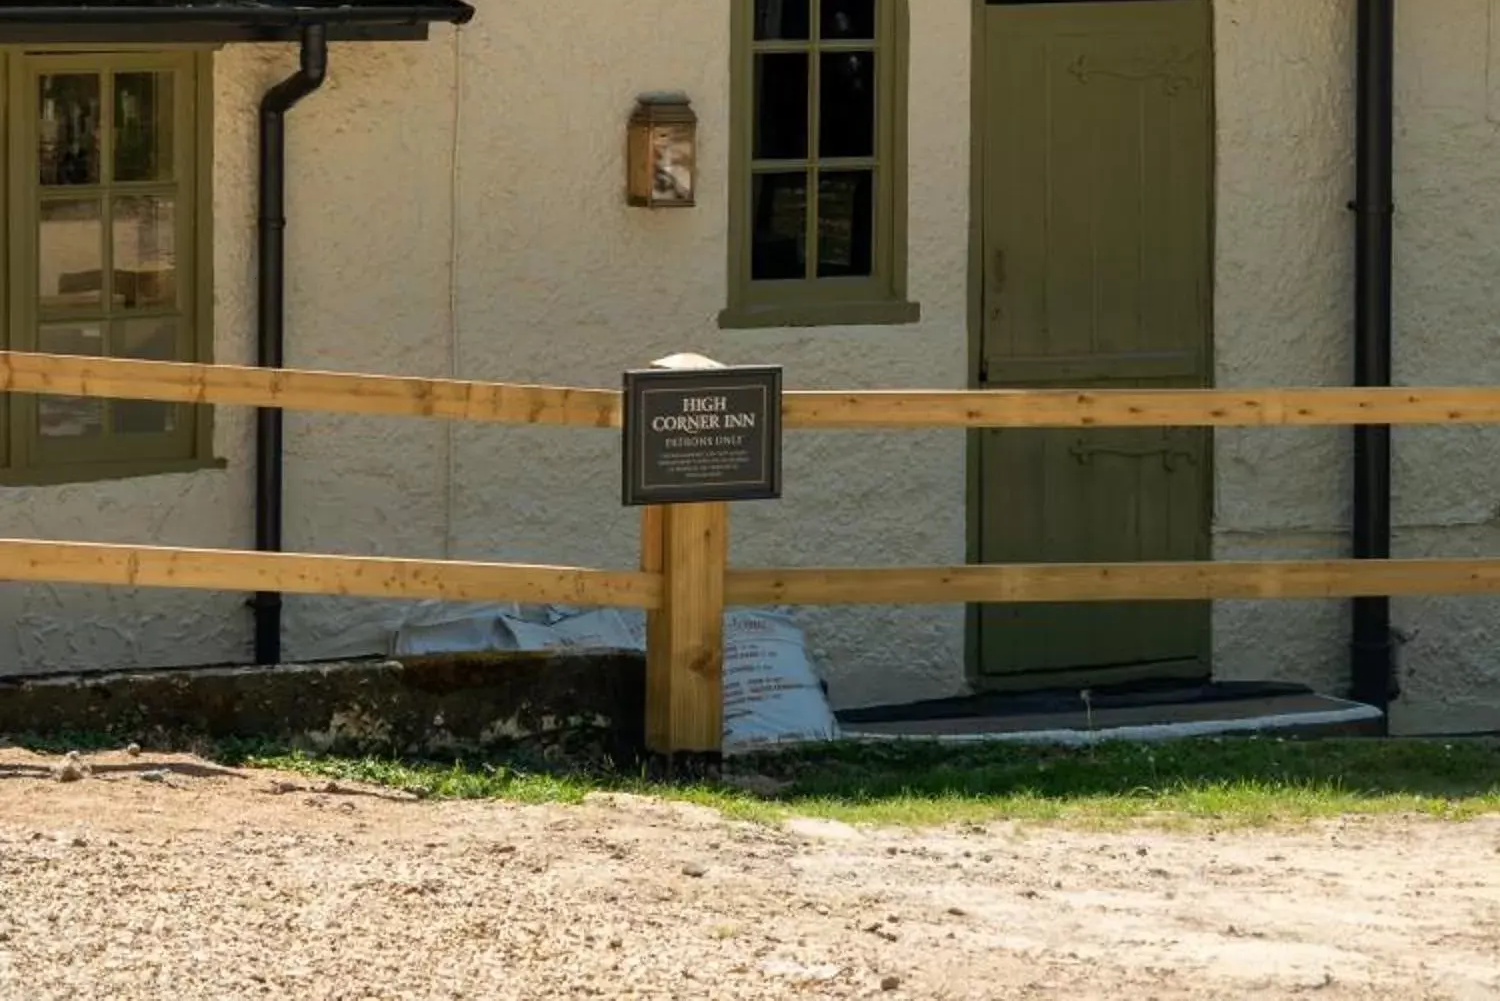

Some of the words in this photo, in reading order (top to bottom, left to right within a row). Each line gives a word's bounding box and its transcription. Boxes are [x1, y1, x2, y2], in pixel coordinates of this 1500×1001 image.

[683, 396, 727, 412] HIGH
[652, 414, 720, 433] CORNER
[724, 413, 756, 428] INN
